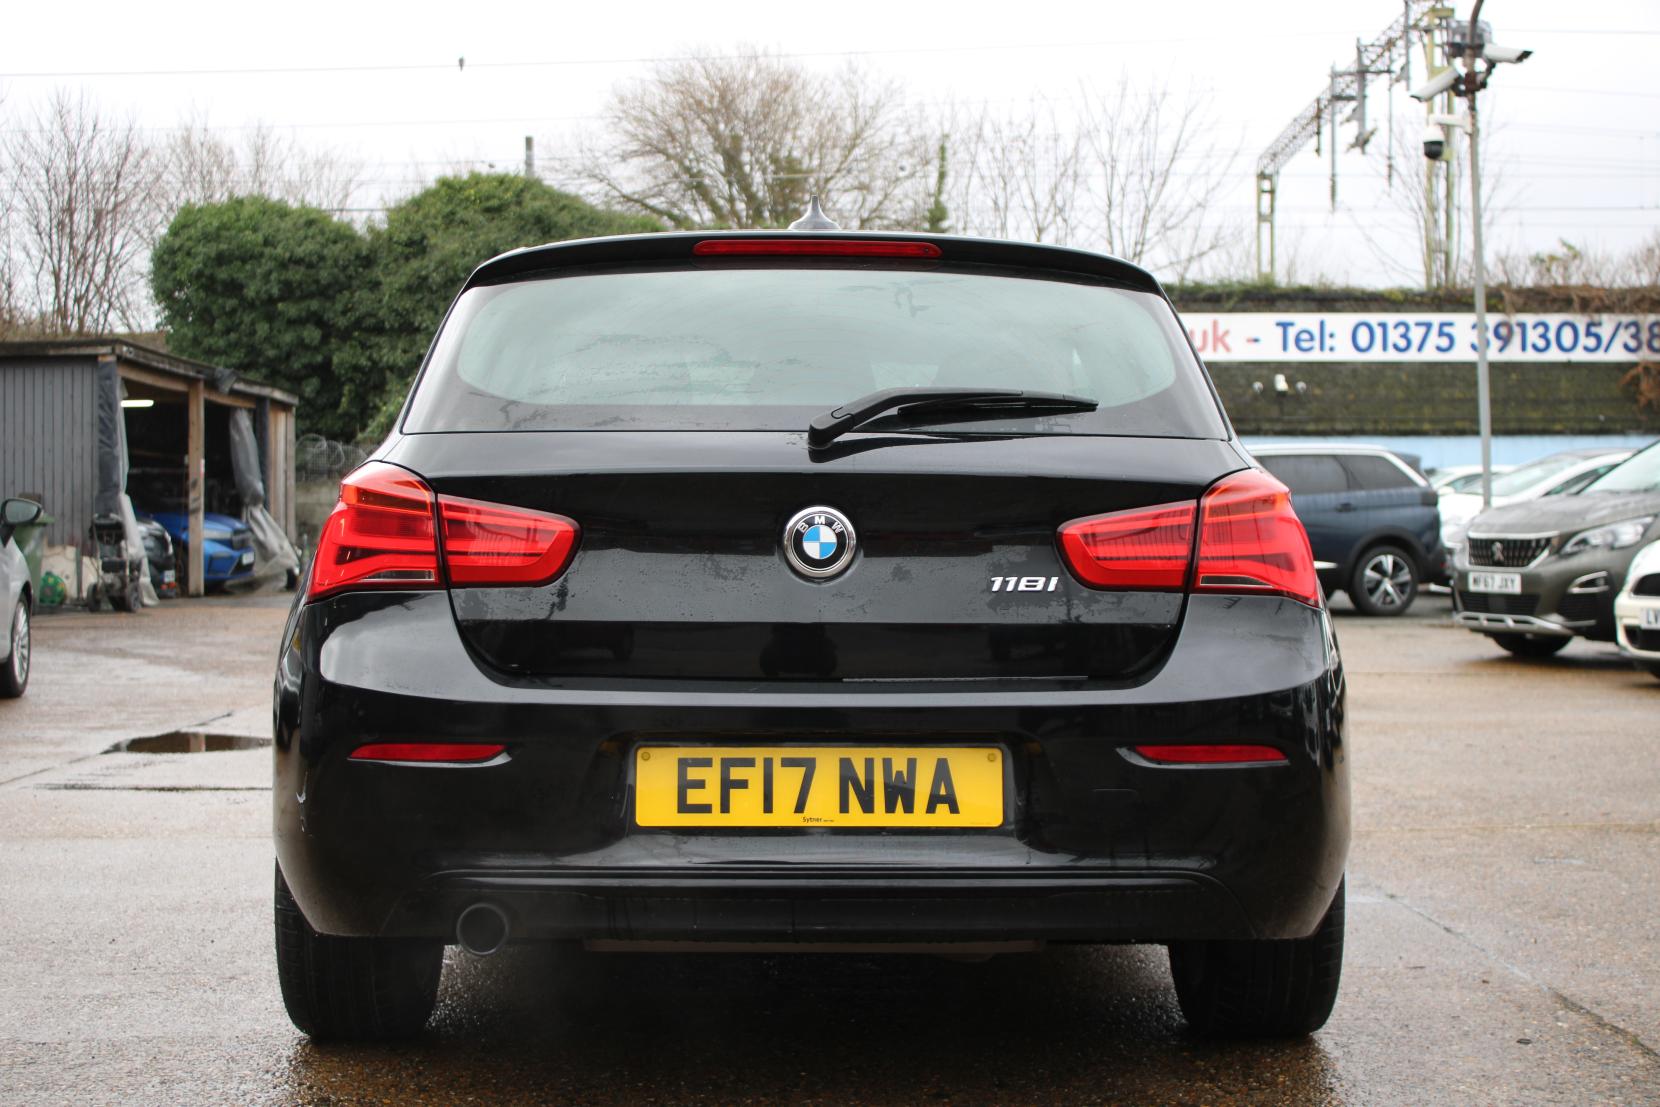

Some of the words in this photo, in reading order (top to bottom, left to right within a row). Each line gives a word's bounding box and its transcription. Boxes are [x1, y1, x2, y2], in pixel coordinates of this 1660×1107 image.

[1275, 320, 1335, 353] Tel:
[1351, 320, 1456, 353] 01375
[797, 515, 844, 534] BMW
[677, 757, 817, 814] EF17
[839, 757, 960, 814] NWA
[802, 816, 823, 824] Sytner
